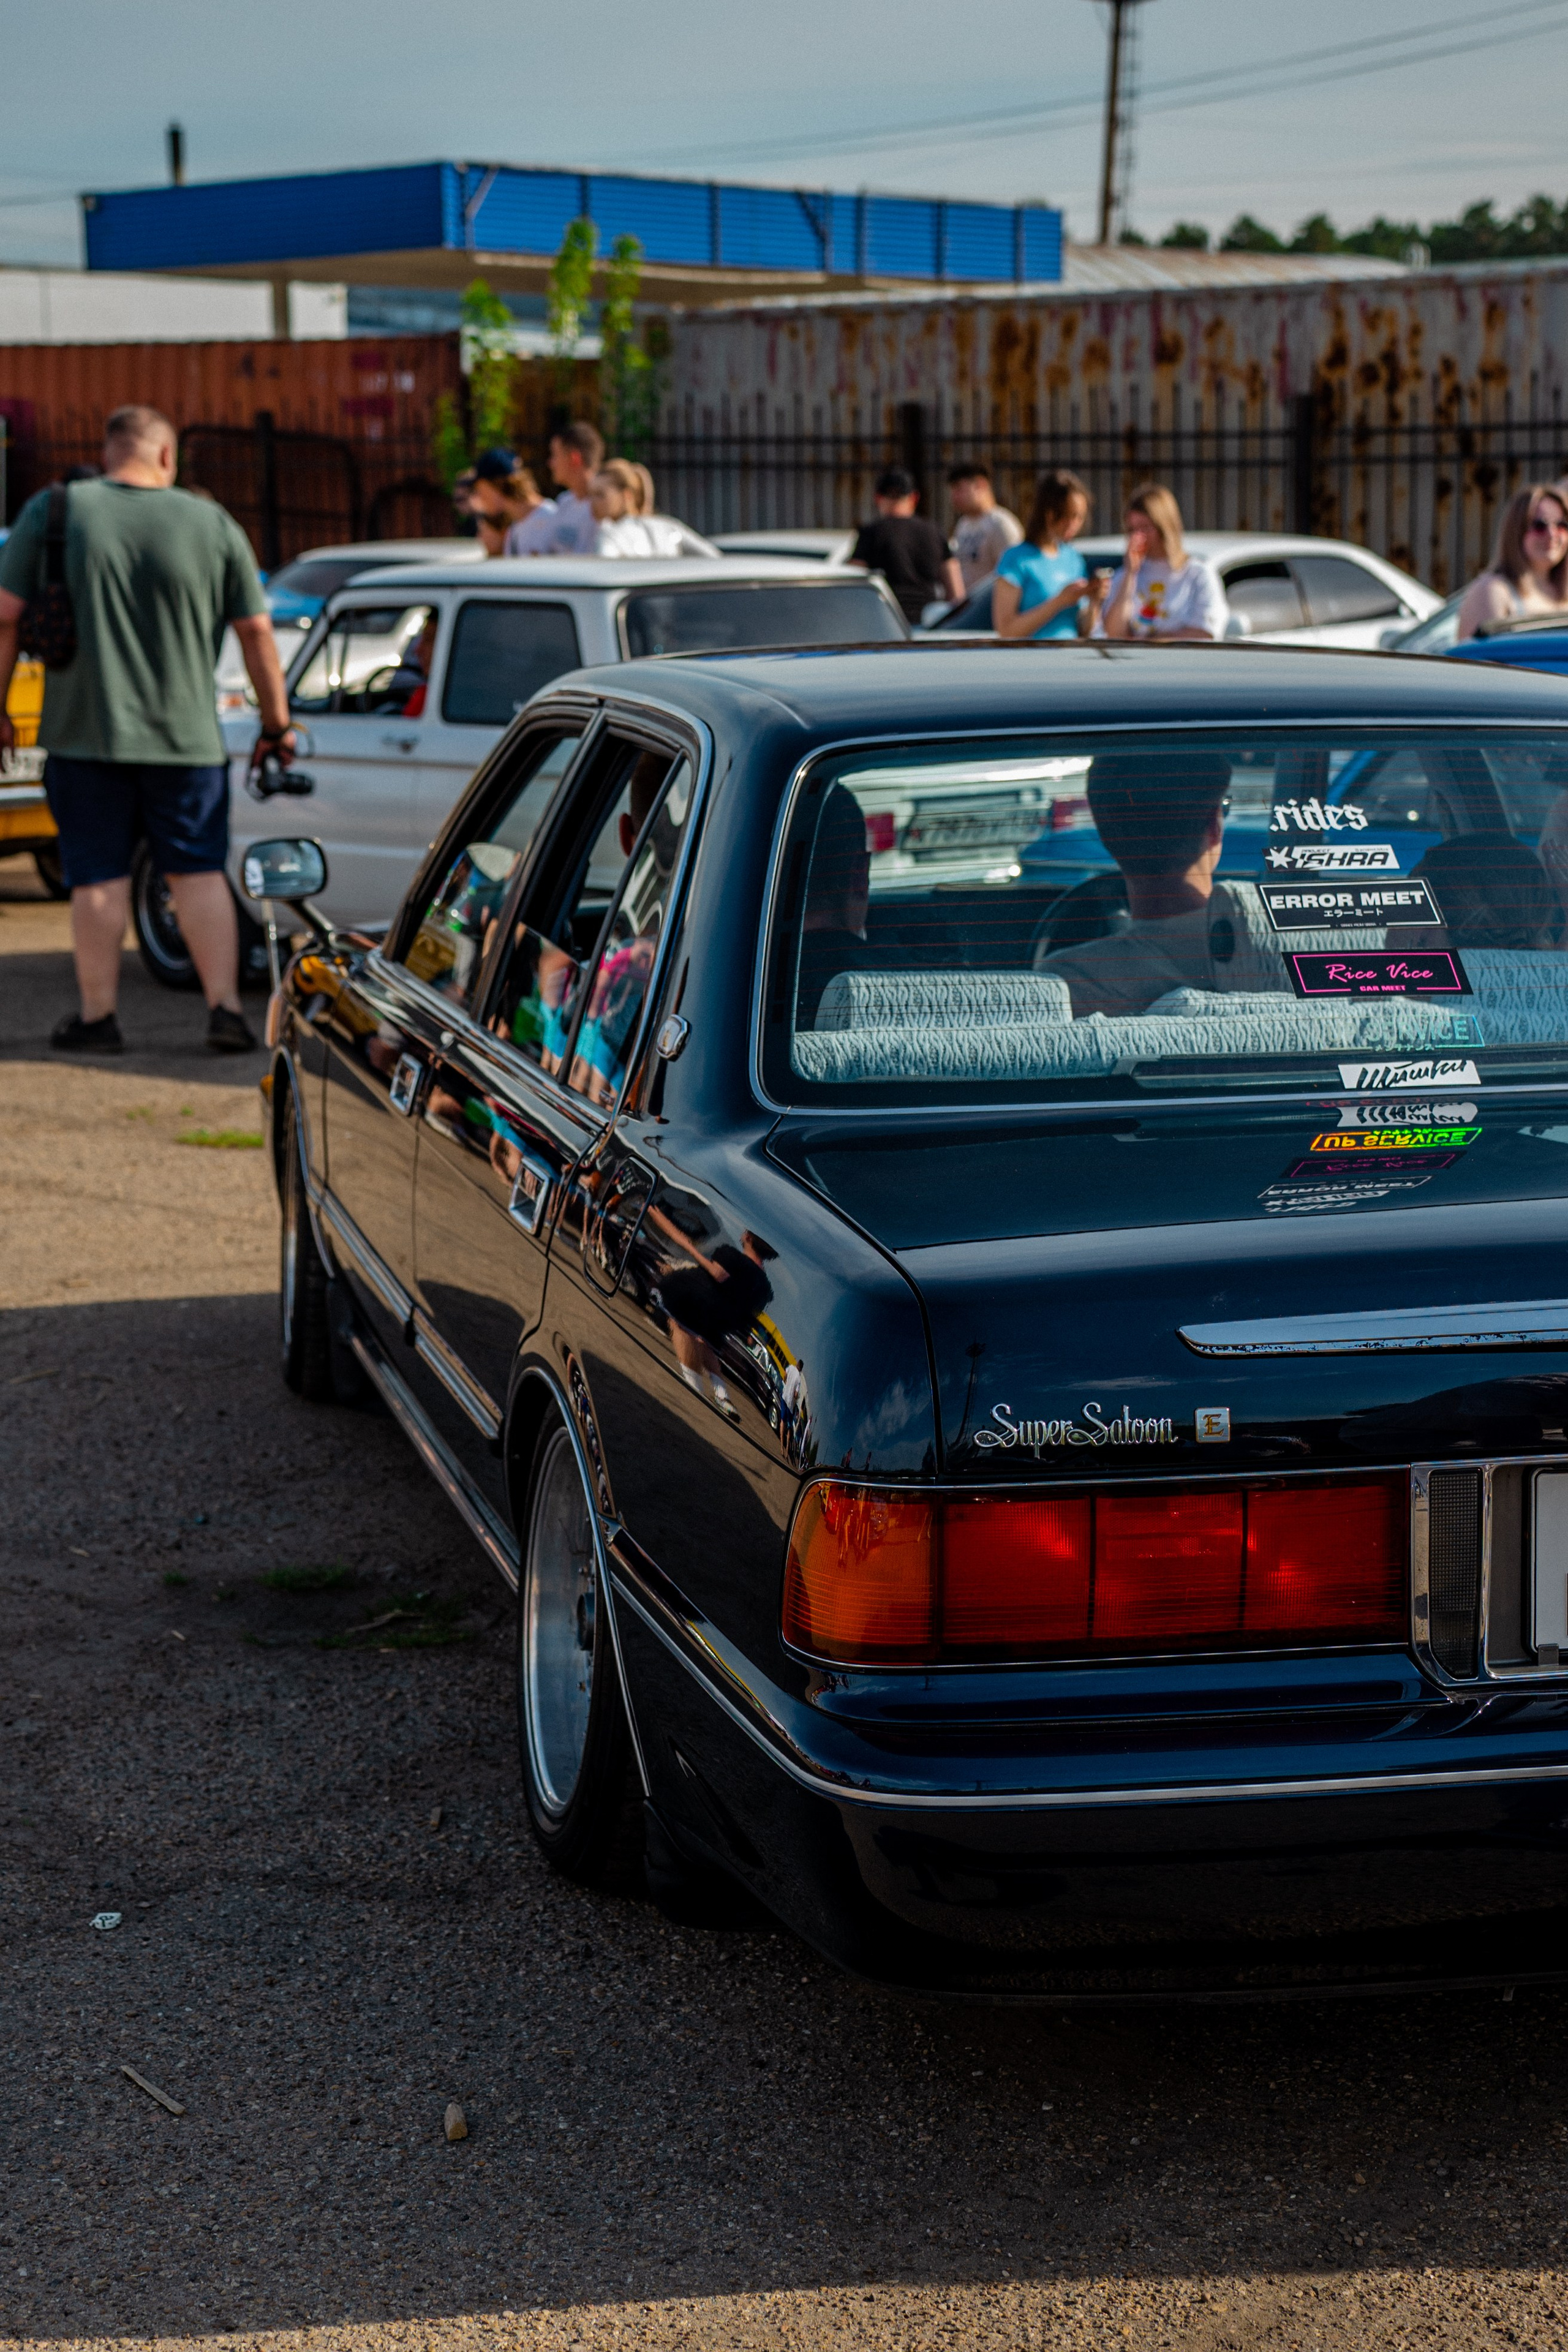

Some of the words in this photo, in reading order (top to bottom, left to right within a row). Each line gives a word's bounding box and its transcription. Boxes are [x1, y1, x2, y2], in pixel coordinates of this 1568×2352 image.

[1270, 892, 1354, 910] ERROR
[1360, 890, 1425, 907] MEET
[1324, 907, 1384, 918] エラーミート
[1325, 963, 1378, 982] Rice
[1386, 962, 1434, 979] Vice
[1365, 1019, 1469, 1042] SERVICE
[973, 1403, 1073, 1460] Super
[1066, 1401, 1179, 1447] Saloon
[1201, 1412, 1224, 1438] E
